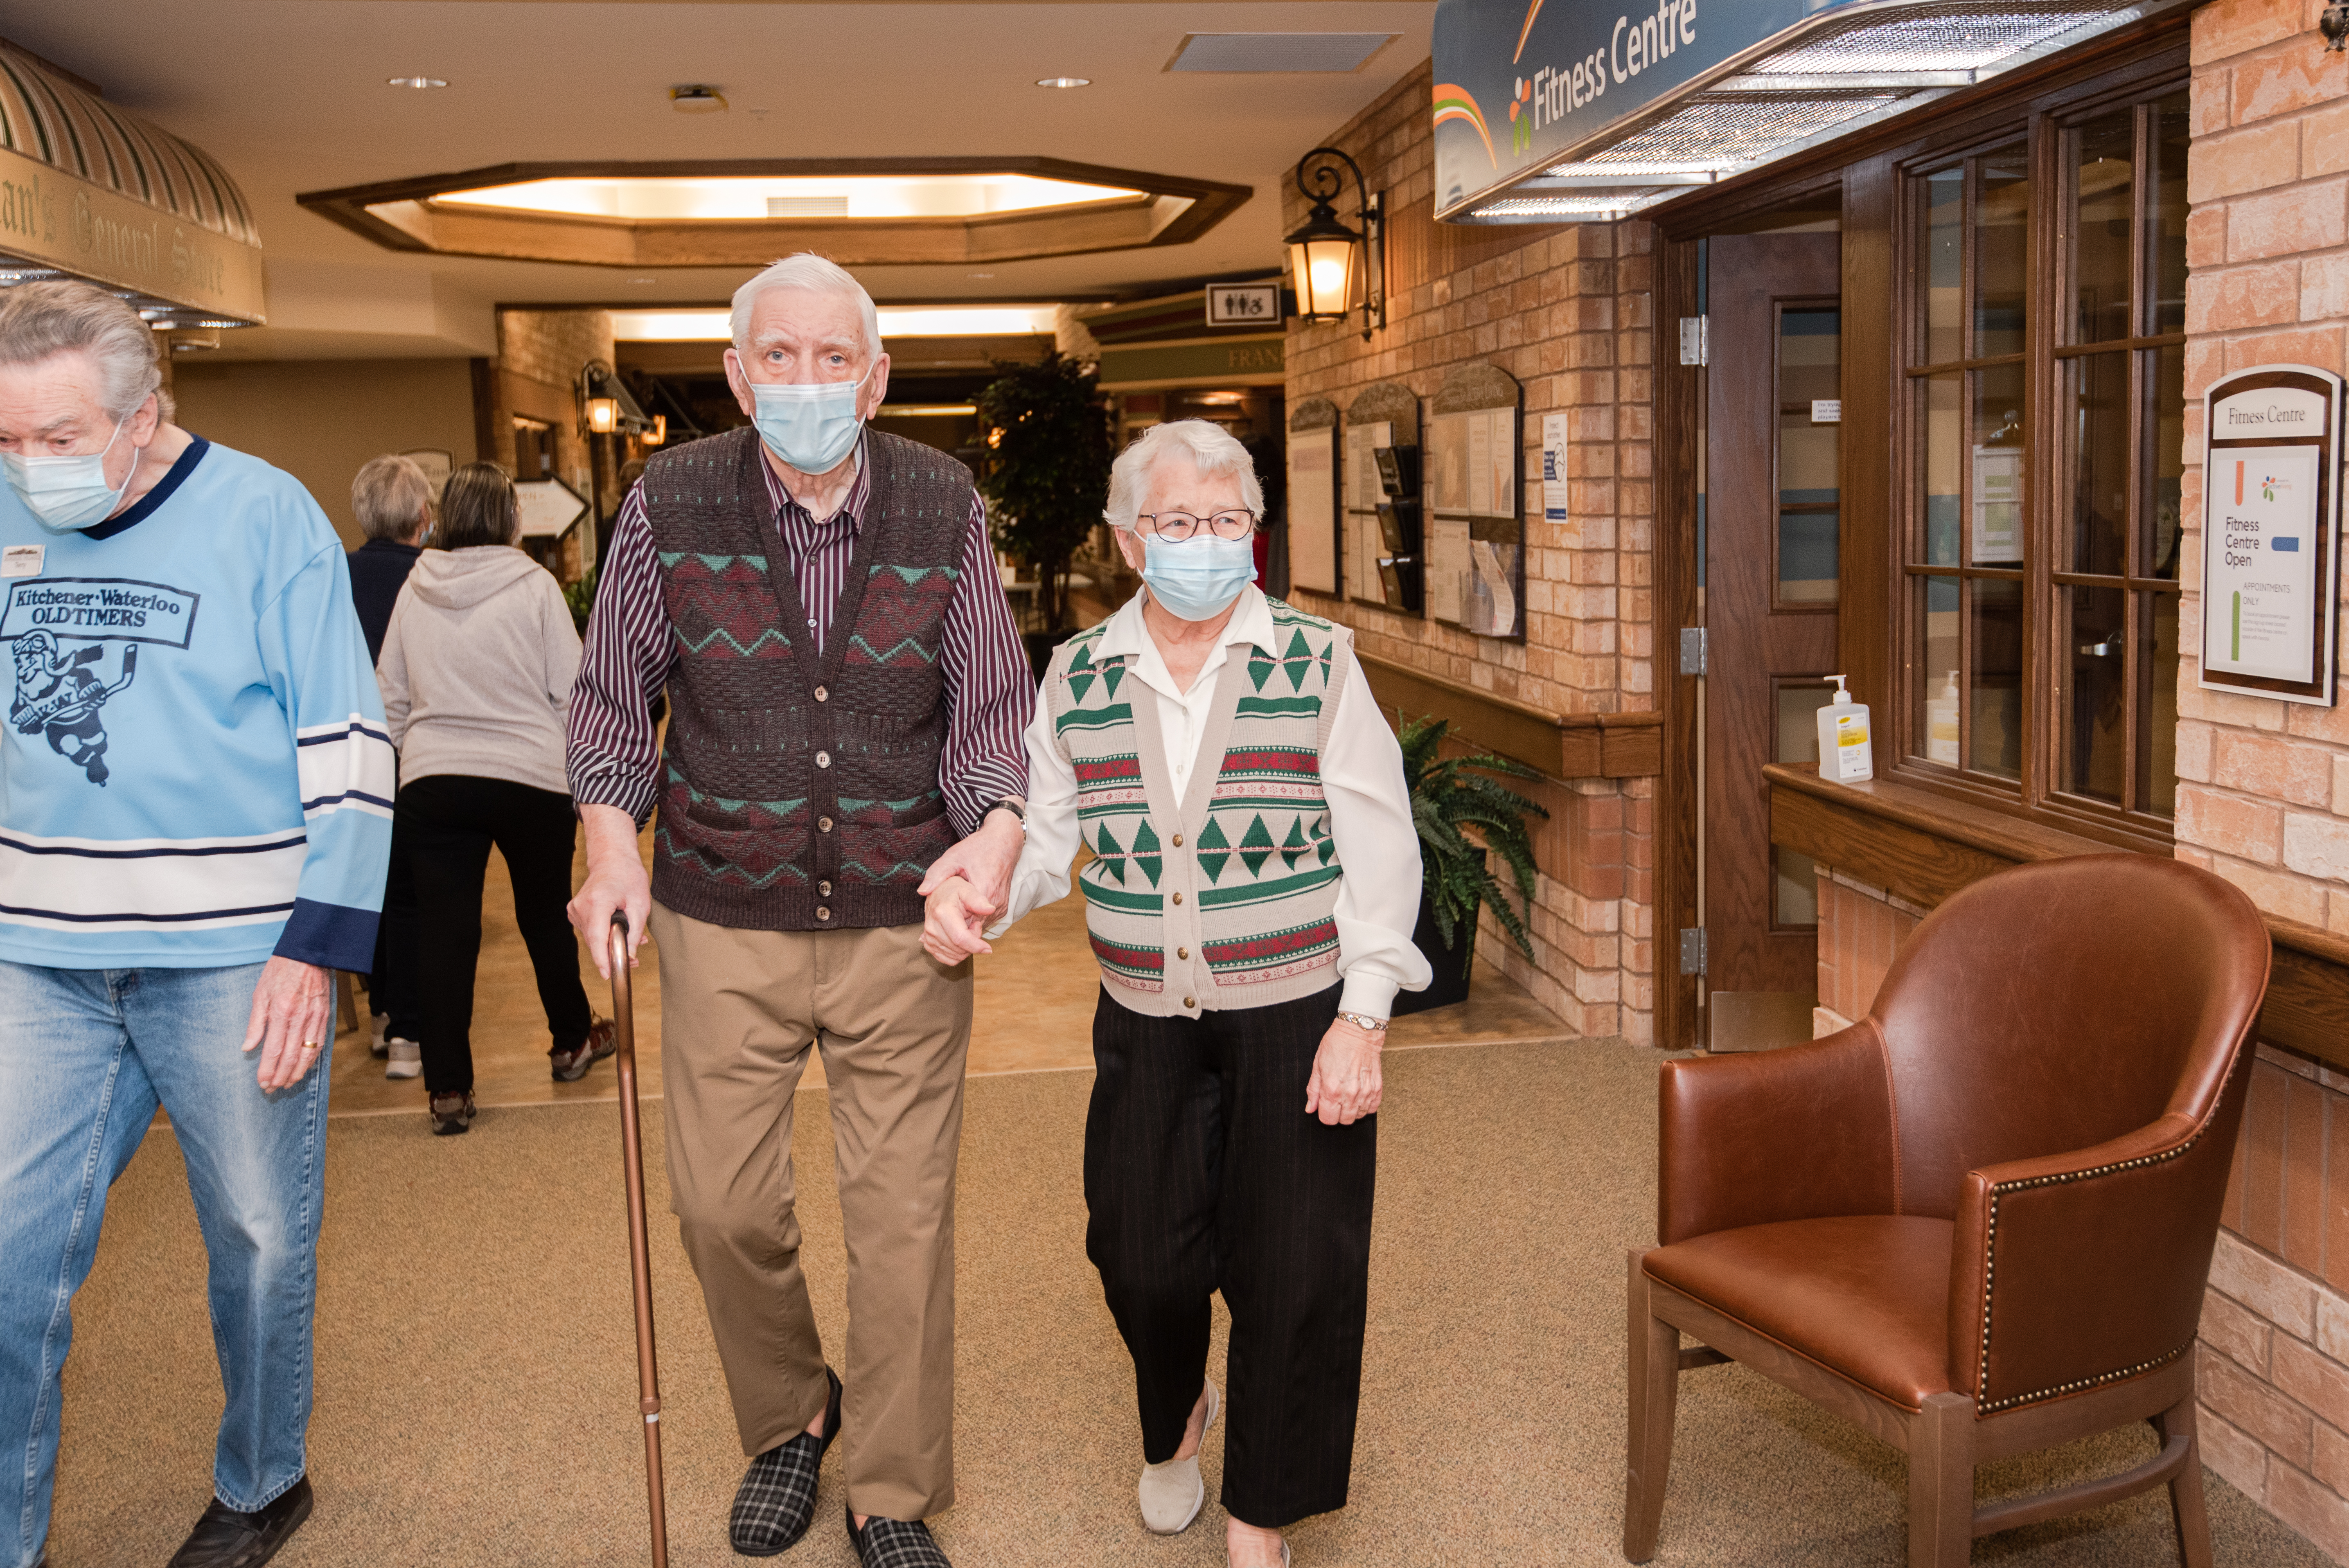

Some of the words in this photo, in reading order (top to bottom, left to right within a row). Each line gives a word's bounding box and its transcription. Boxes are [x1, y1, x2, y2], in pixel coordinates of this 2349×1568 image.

[1534, 48, 1606, 130] Fitness
[1611, 0, 1696, 83] Centre
[0, 173, 56, 243] an's
[71, 187, 160, 274] General
[172, 226, 225, 296] Store
[2229, 408, 2264, 424] Fitness
[2268, 405, 2305, 422] Centre
[2226, 516, 2259, 531] Fitness
[2225, 534, 2259, 549] Centre
[2225, 552, 2251, 569] Open
[2243, 582, 2290, 593] APPOINTMENTS
[2243, 597, 2259, 605] ONLY
